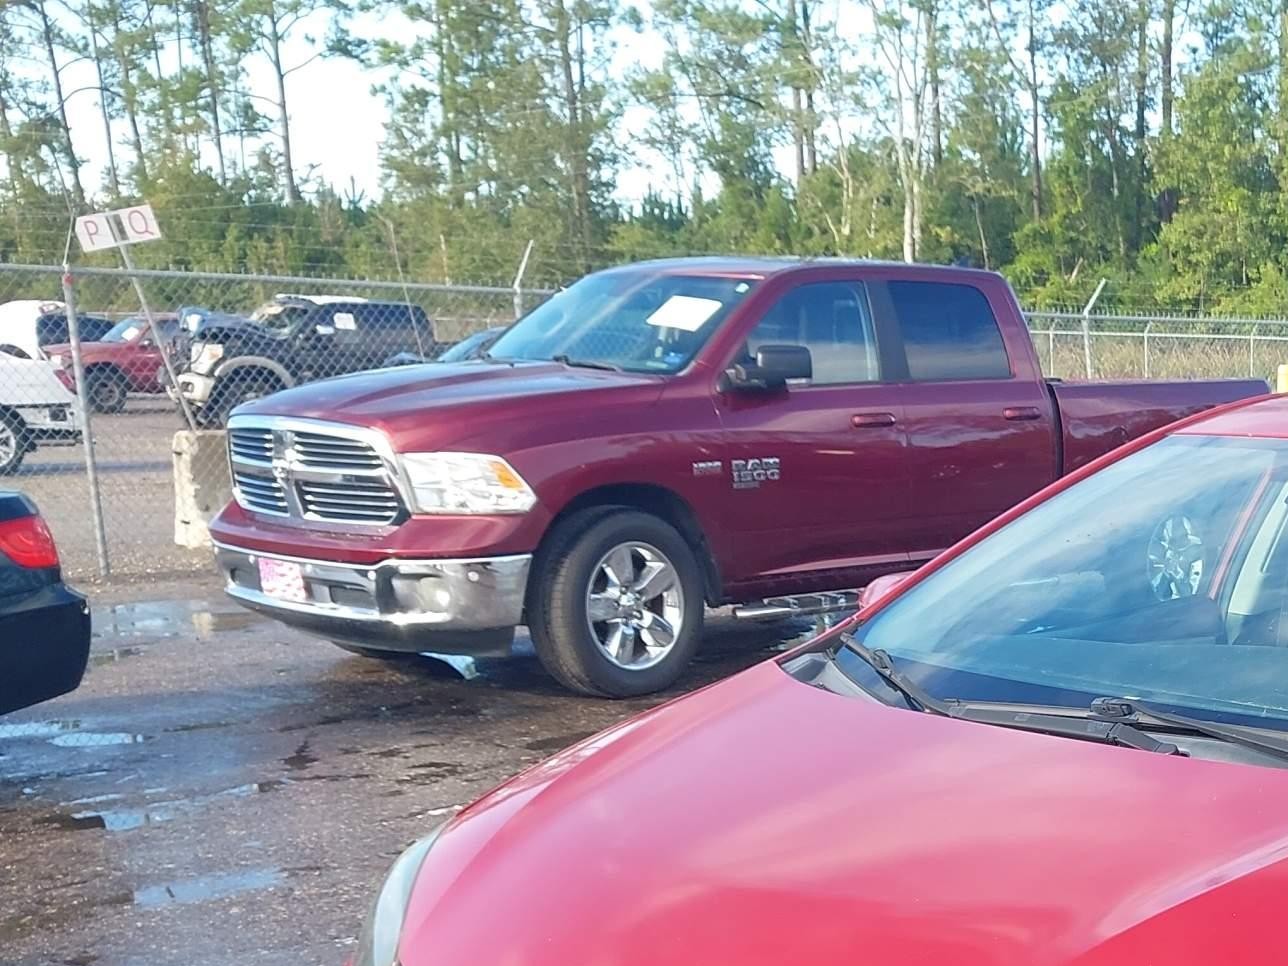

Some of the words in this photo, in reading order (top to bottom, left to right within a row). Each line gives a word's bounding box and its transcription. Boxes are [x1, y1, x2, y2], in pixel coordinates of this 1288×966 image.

[83, 220, 99, 246] P
[128, 210, 154, 236] Q
[731, 458, 780, 471] RAM
[732, 470, 780, 482] 1500
